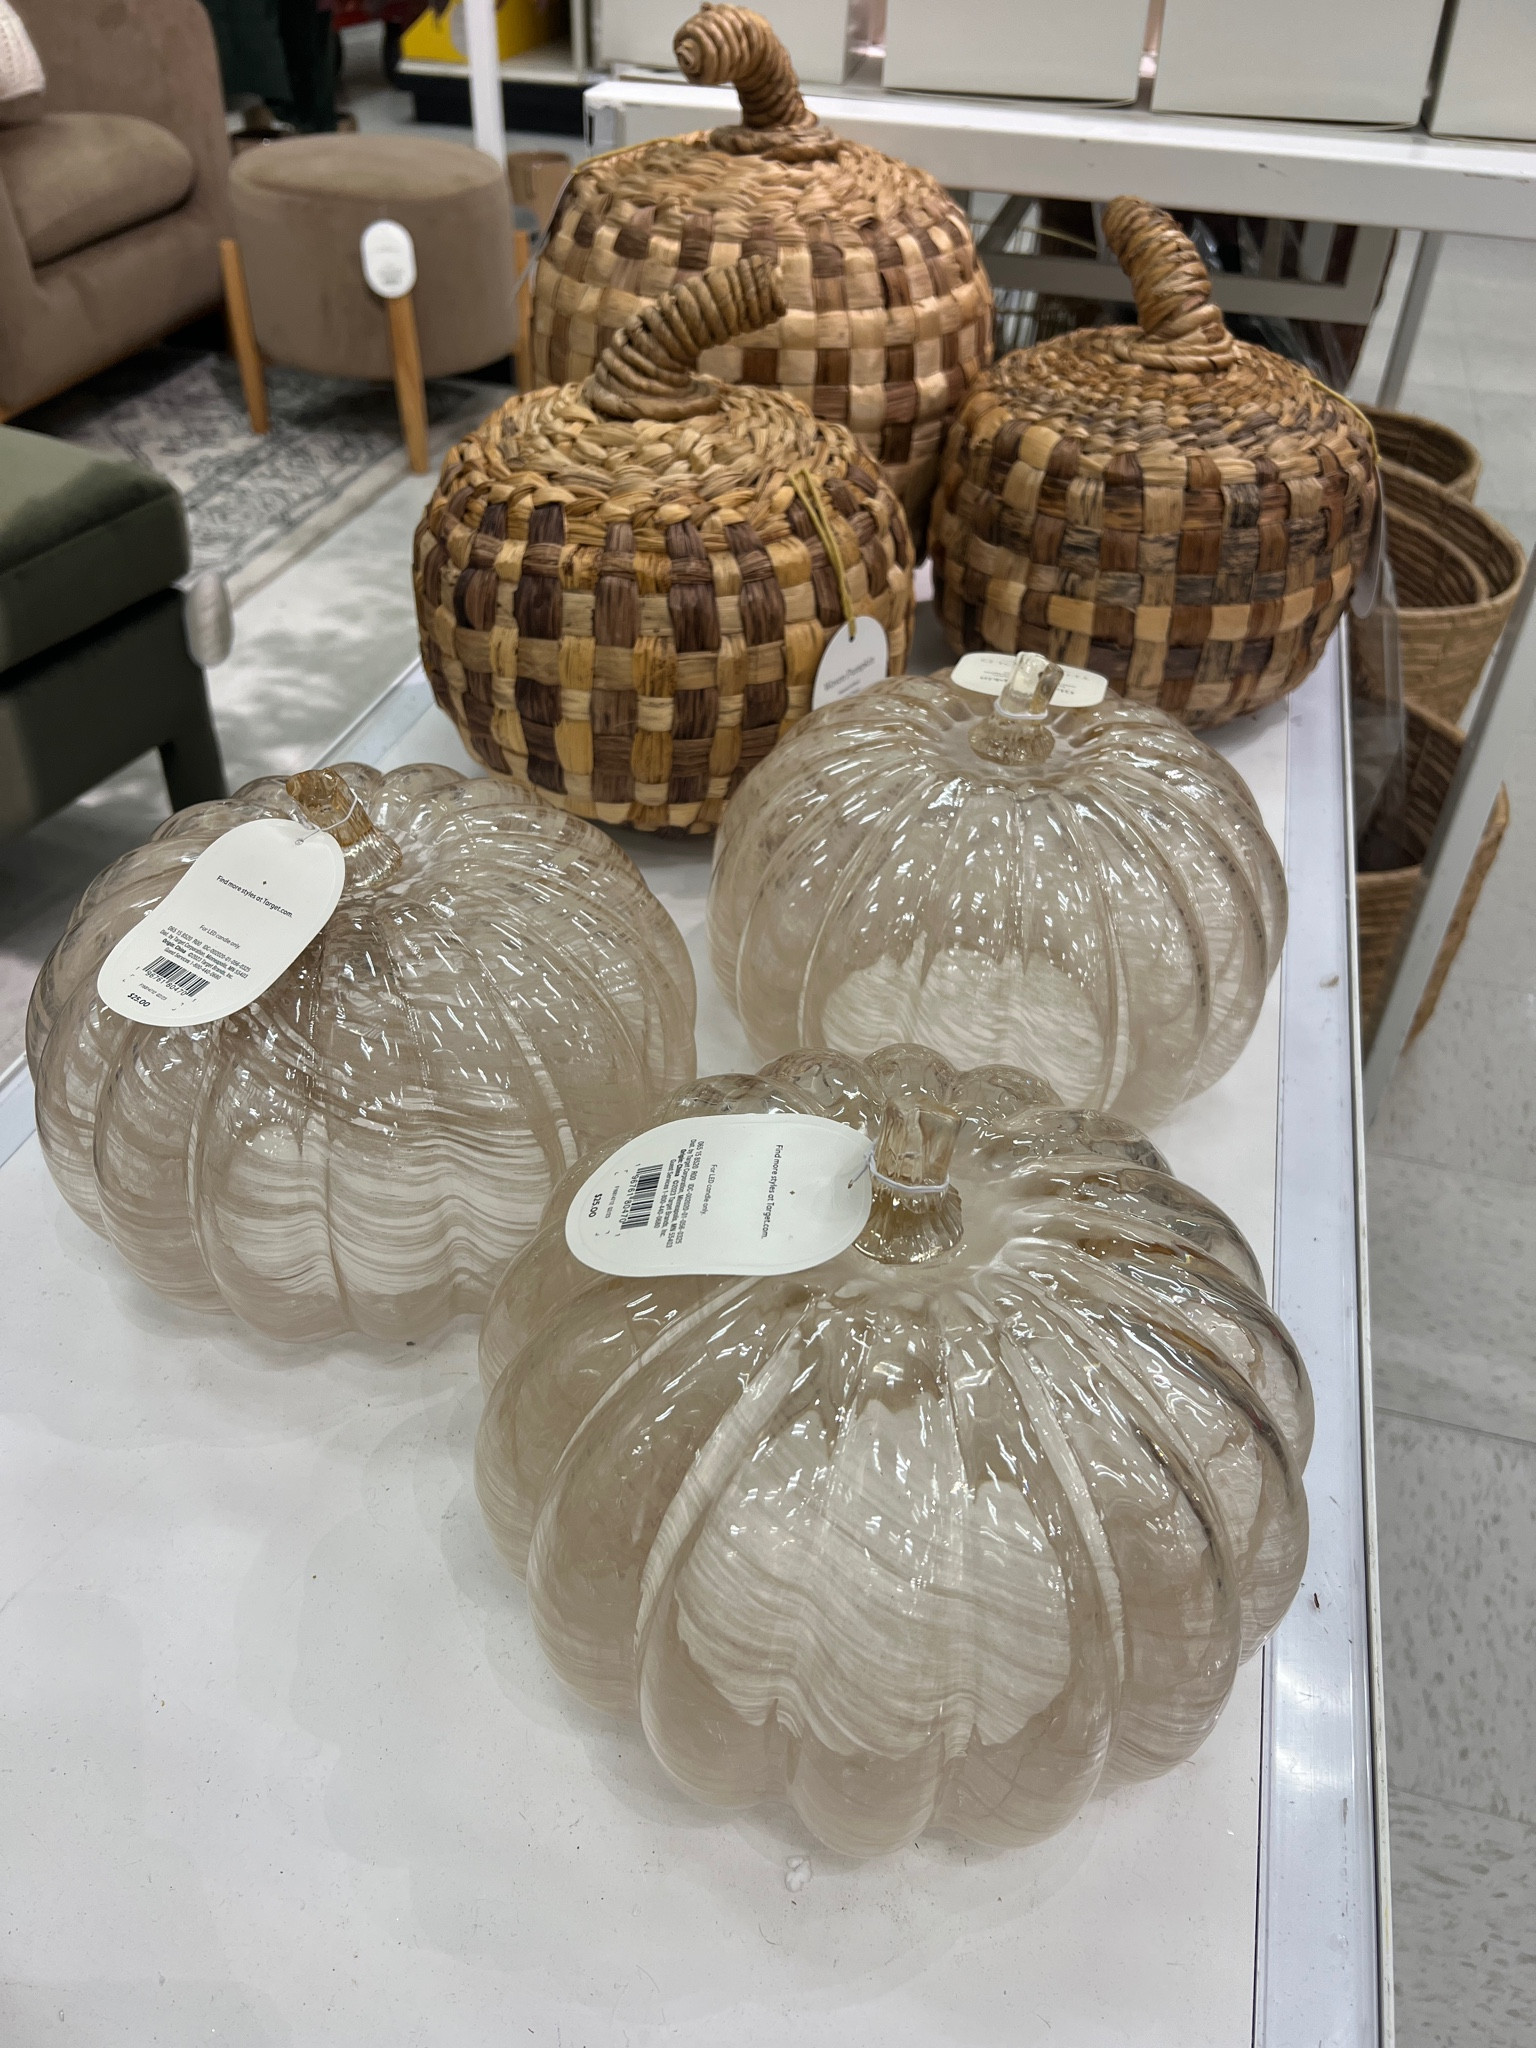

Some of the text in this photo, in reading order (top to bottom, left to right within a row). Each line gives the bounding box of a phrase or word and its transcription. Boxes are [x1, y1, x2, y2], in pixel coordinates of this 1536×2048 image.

[217, 875, 229, 885] Find
[228, 882, 242, 891] more
[241, 888, 256, 900] styles
[263, 898, 293, 918] Target.com.
[174, 936, 185, 945] Target
[216, 934, 231, 944] candle
[162, 938, 175, 947] Origin:
[175, 945, 186, 954] China
[201, 960, 213, 968] Target
[164, 947, 176, 955] Guest
[174, 953, 190, 964] Services
[128, 993, 151, 1007] $25.00
[678, 1149, 686, 1163] Origin:
[774, 1145, 783, 1158] Find
[684, 1154, 693, 1167] Target
[692, 1157, 700, 1169] 8520
[626, 1174, 639, 1196] 96761
[664, 1172, 673, 1189] Services
[678, 1168, 690, 1194] Corporation,
[769, 1176, 777, 1193] styles
[704, 1184, 712, 1202] candle
[588, 1194, 602, 1217] $25.00
[619, 1200, 632, 1223] 80470
[666, 1197, 675, 1210] Target
[700, 1203, 708, 1216] only.
[662, 1211, 672, 1228] Brands,
[670, 1223, 677, 1231] MN
[761, 1202, 774, 1239] Target.com.
[666, 1232, 675, 1248] 55403
